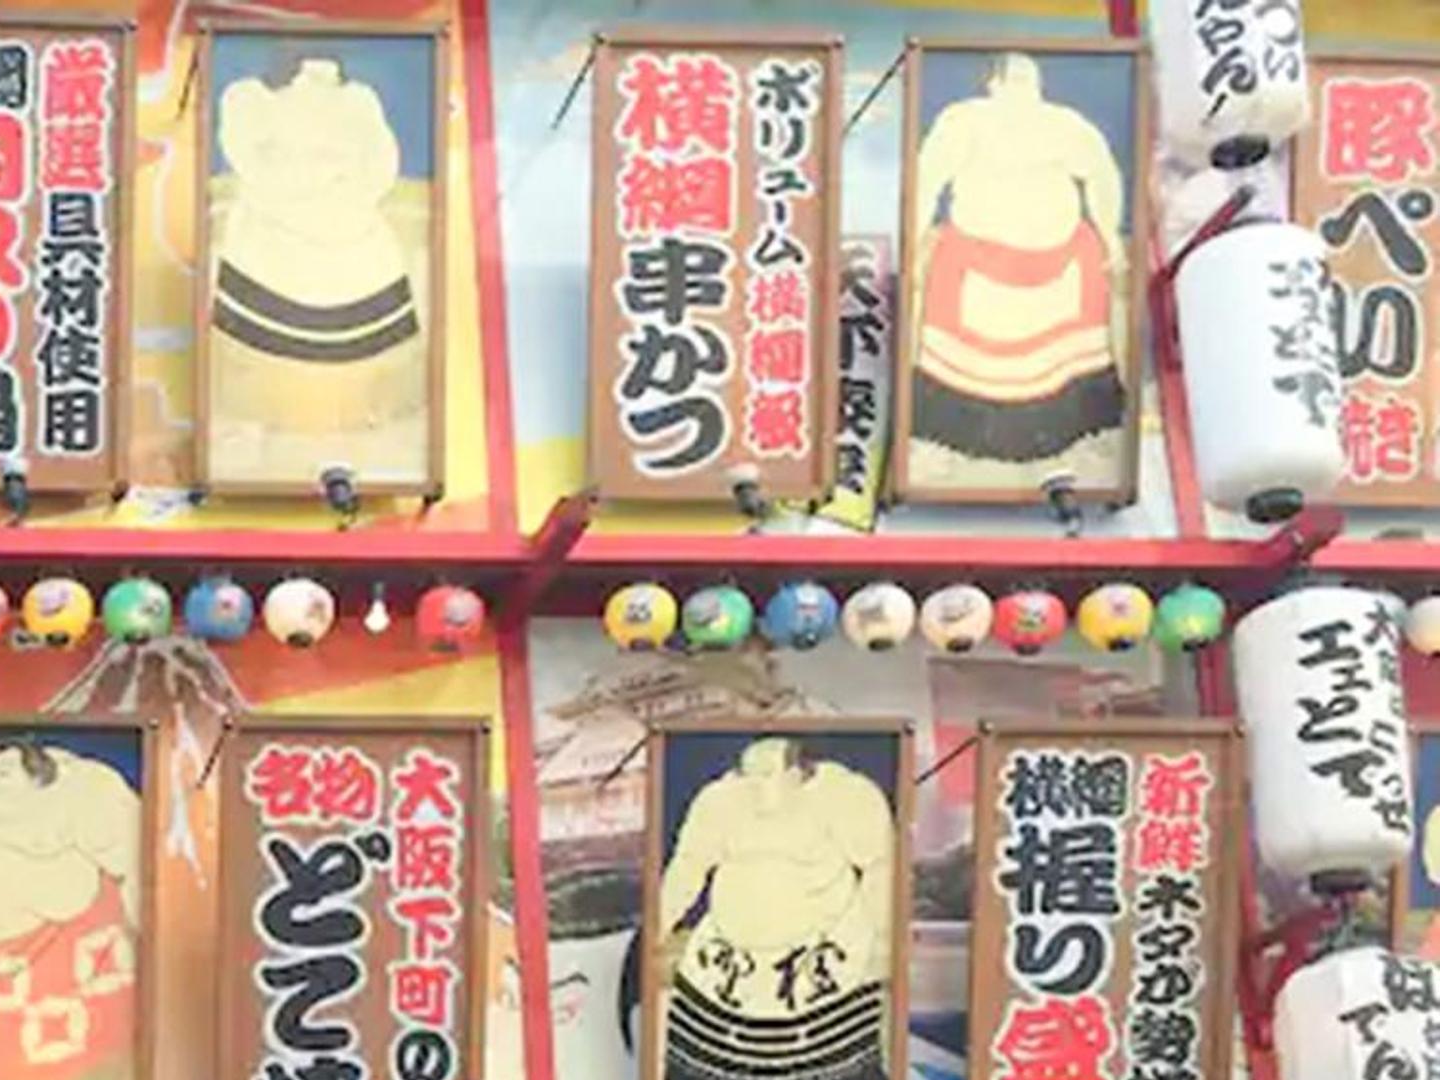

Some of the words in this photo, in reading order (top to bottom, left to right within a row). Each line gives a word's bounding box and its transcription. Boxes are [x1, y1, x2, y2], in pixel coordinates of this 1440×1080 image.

[41, 46, 104, 450] 厳選具材使用
[622, 59, 733, 468] 横綱串かつ
[252, 748, 379, 820] 名物
[1008, 755, 1127, 816] 横綱
